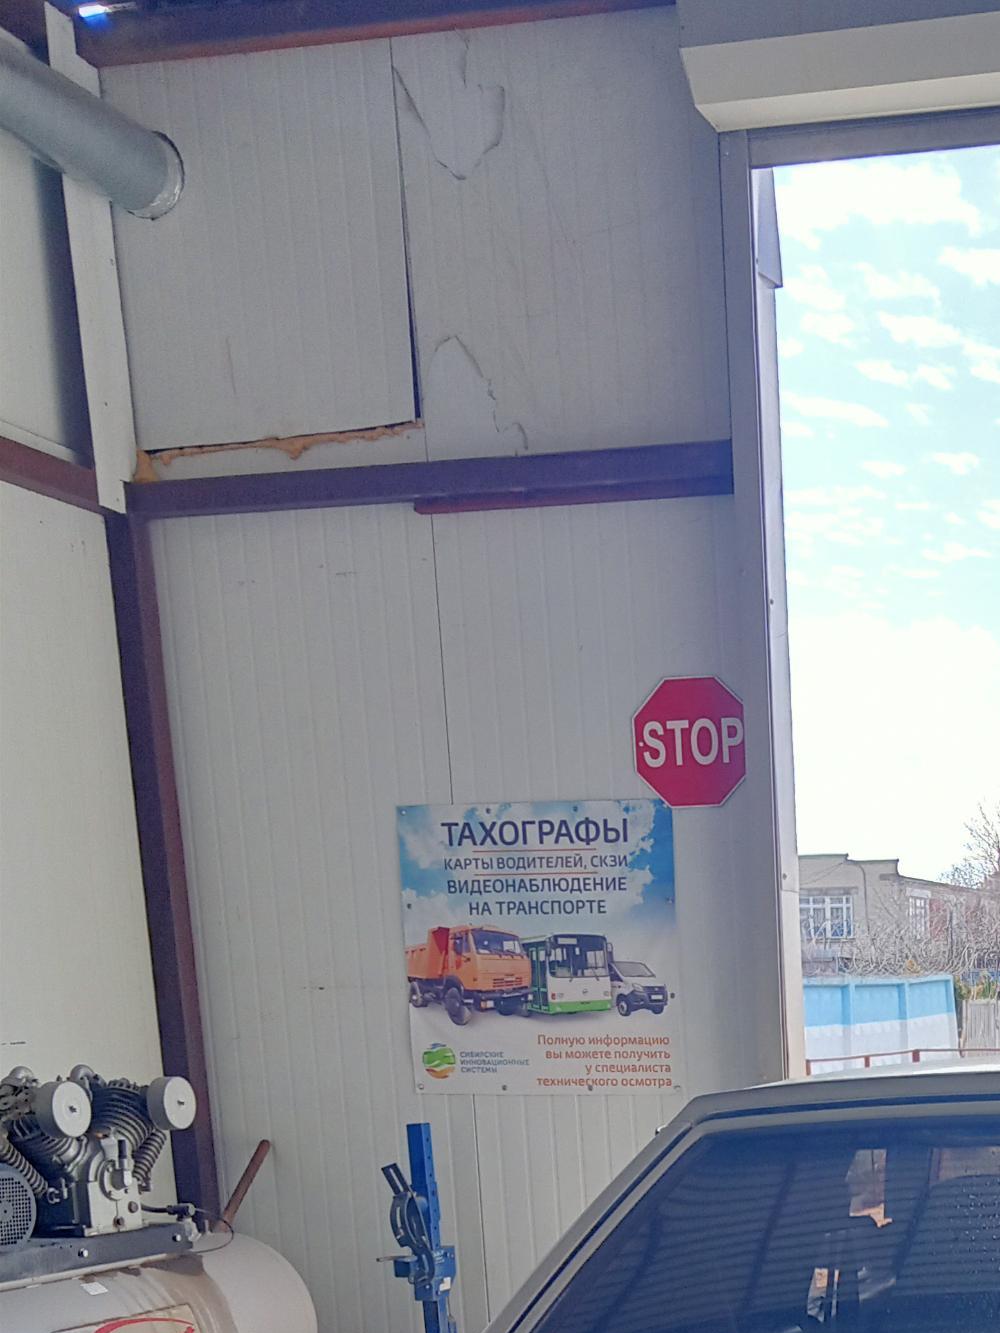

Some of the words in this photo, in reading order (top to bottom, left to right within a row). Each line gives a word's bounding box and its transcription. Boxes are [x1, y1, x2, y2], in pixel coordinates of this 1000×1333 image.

[643, 717, 744, 768] STOP
[440, 817, 629, 847] ТАХОГРАФЫ
[444, 857, 493, 871] КАРТЫ
[496, 853, 587, 871] ВОДИТЕЛЕЙ,
[590, 854, 628, 868] СКЗИ
[447, 876, 627, 895] ВИДЕОНАБЛЮДЕНИЕ
[469, 901, 492, 916] НА
[495, 899, 608, 916] ТРАНСПОРТЕ
[537, 1034, 586, 1047] Полную
[588, 1033, 670, 1048] информацию
[545, 1050, 562, 1059] вы
[565, 1050, 612, 1059] можете
[614, 1050, 671, 1061] получить
[585, 1064, 592, 1075] у
[595, 1063, 671, 1074] специалиста
[537, 1077, 618, 1087] технического
[621, 1077, 672, 1088] осмотра
